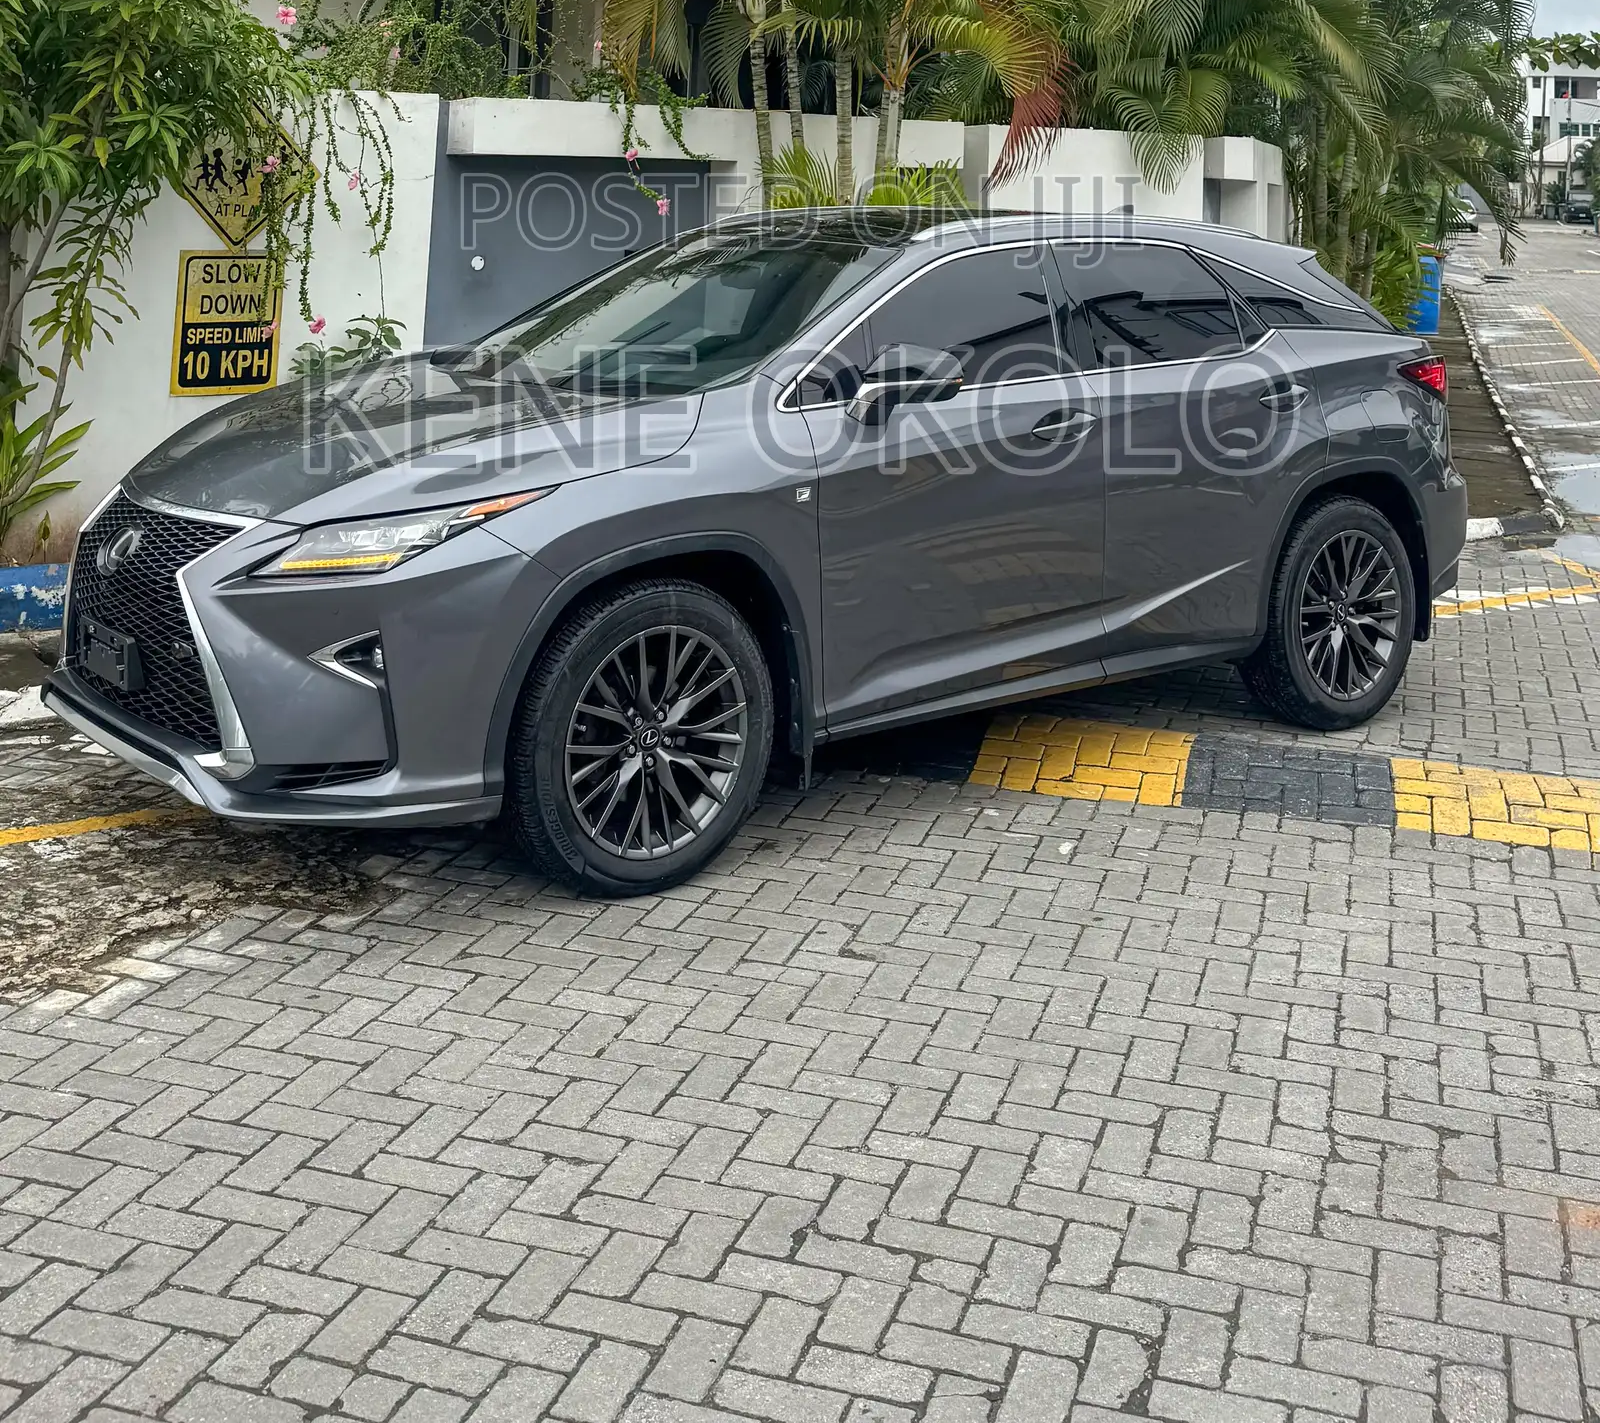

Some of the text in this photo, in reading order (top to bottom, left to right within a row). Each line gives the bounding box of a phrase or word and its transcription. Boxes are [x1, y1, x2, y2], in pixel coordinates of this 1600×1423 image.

[214, 203, 262, 219] AT PLA
[201, 263, 261, 284] SLOW
[200, 294, 262, 315] DOWN
[186, 328, 232, 345] SPEED
[183, 348, 269, 380] 10 KPH
